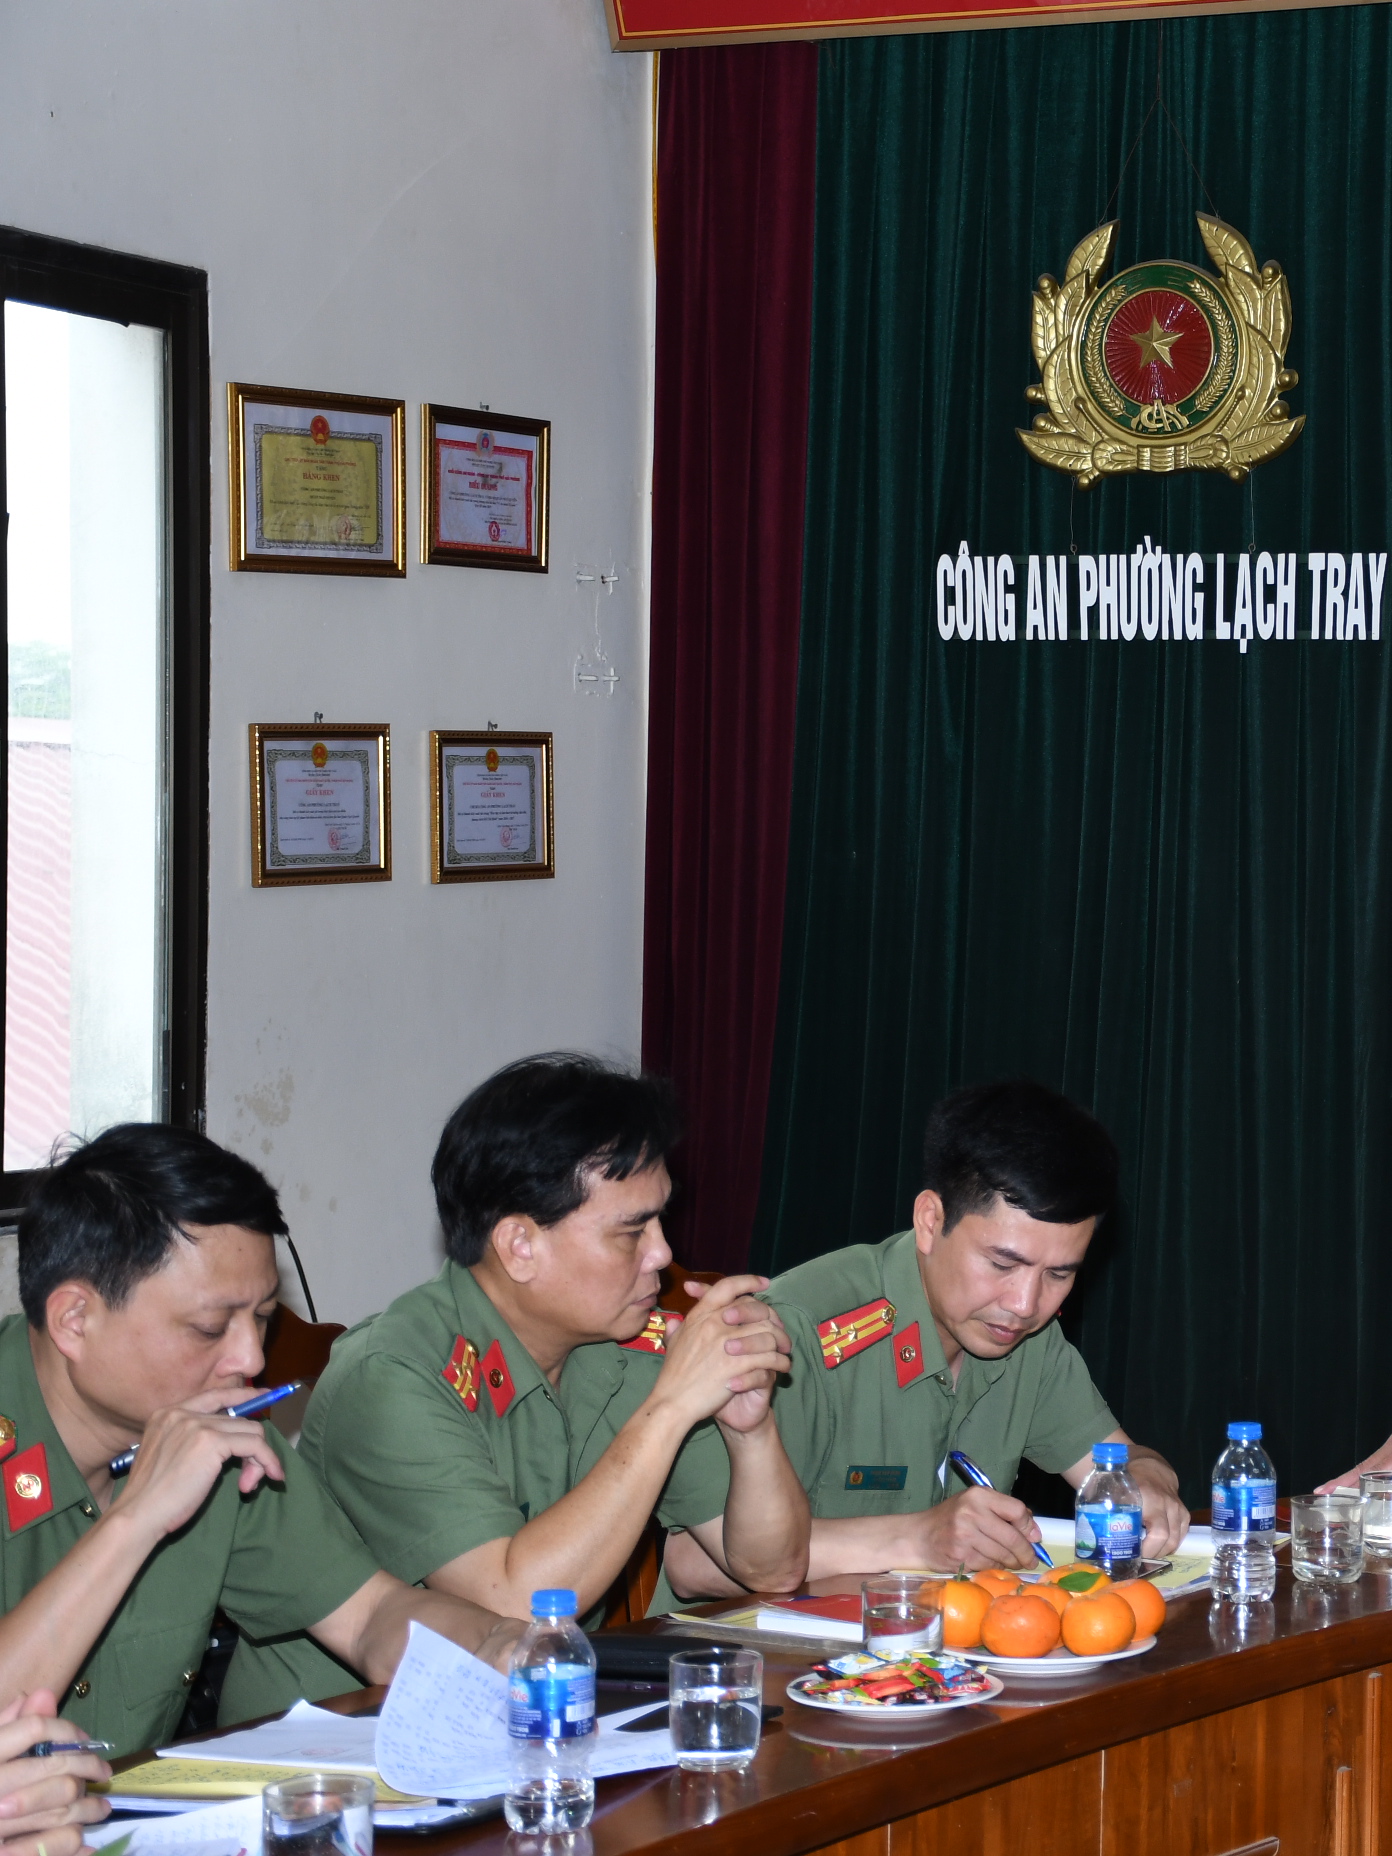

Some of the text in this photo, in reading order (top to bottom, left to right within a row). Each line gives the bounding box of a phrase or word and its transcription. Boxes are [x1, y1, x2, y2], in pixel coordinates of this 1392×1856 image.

[323, 473, 340, 481] KHEN
[936, 535, 1387, 654] CÔNG AN PHƯỜNG LẠCH TRAY
[1109, 1521, 1132, 1531] laVie
